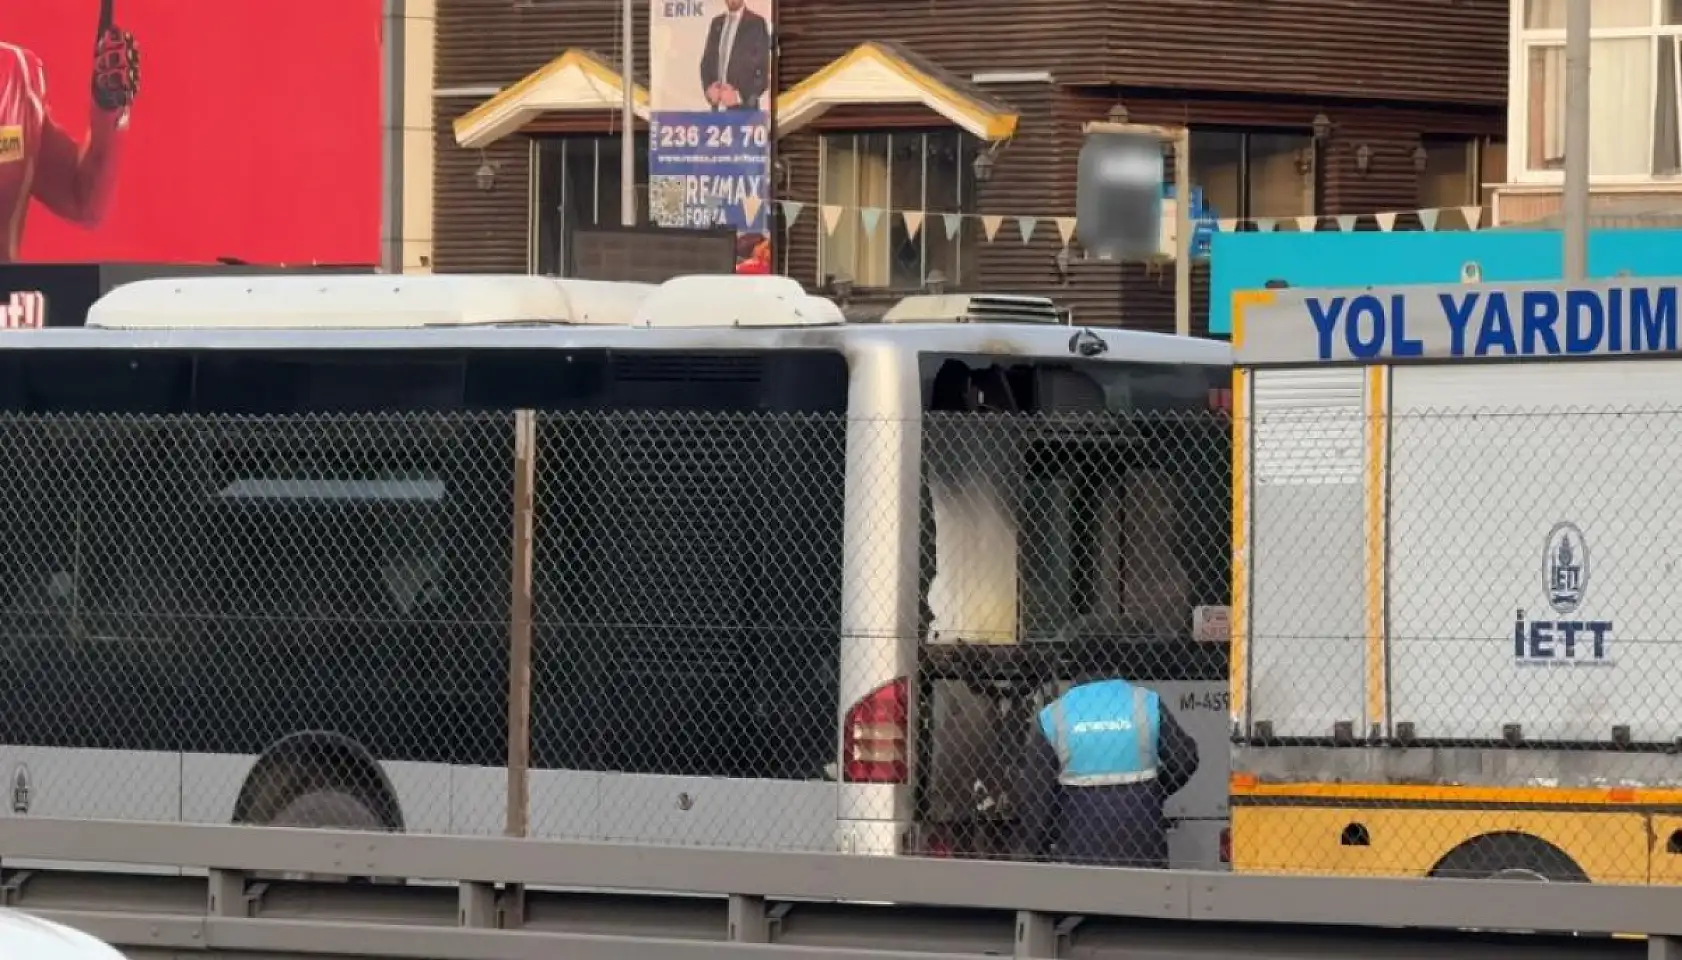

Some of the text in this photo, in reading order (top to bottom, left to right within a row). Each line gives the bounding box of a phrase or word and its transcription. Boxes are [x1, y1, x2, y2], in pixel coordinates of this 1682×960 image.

[660, 125, 699, 148] 236
[706, 125, 733, 148] 24
[740, 125, 767, 148] 70
[1305, 286, 1678, 359] YOL YARDIM
[1515, 608, 1613, 658] İETT
